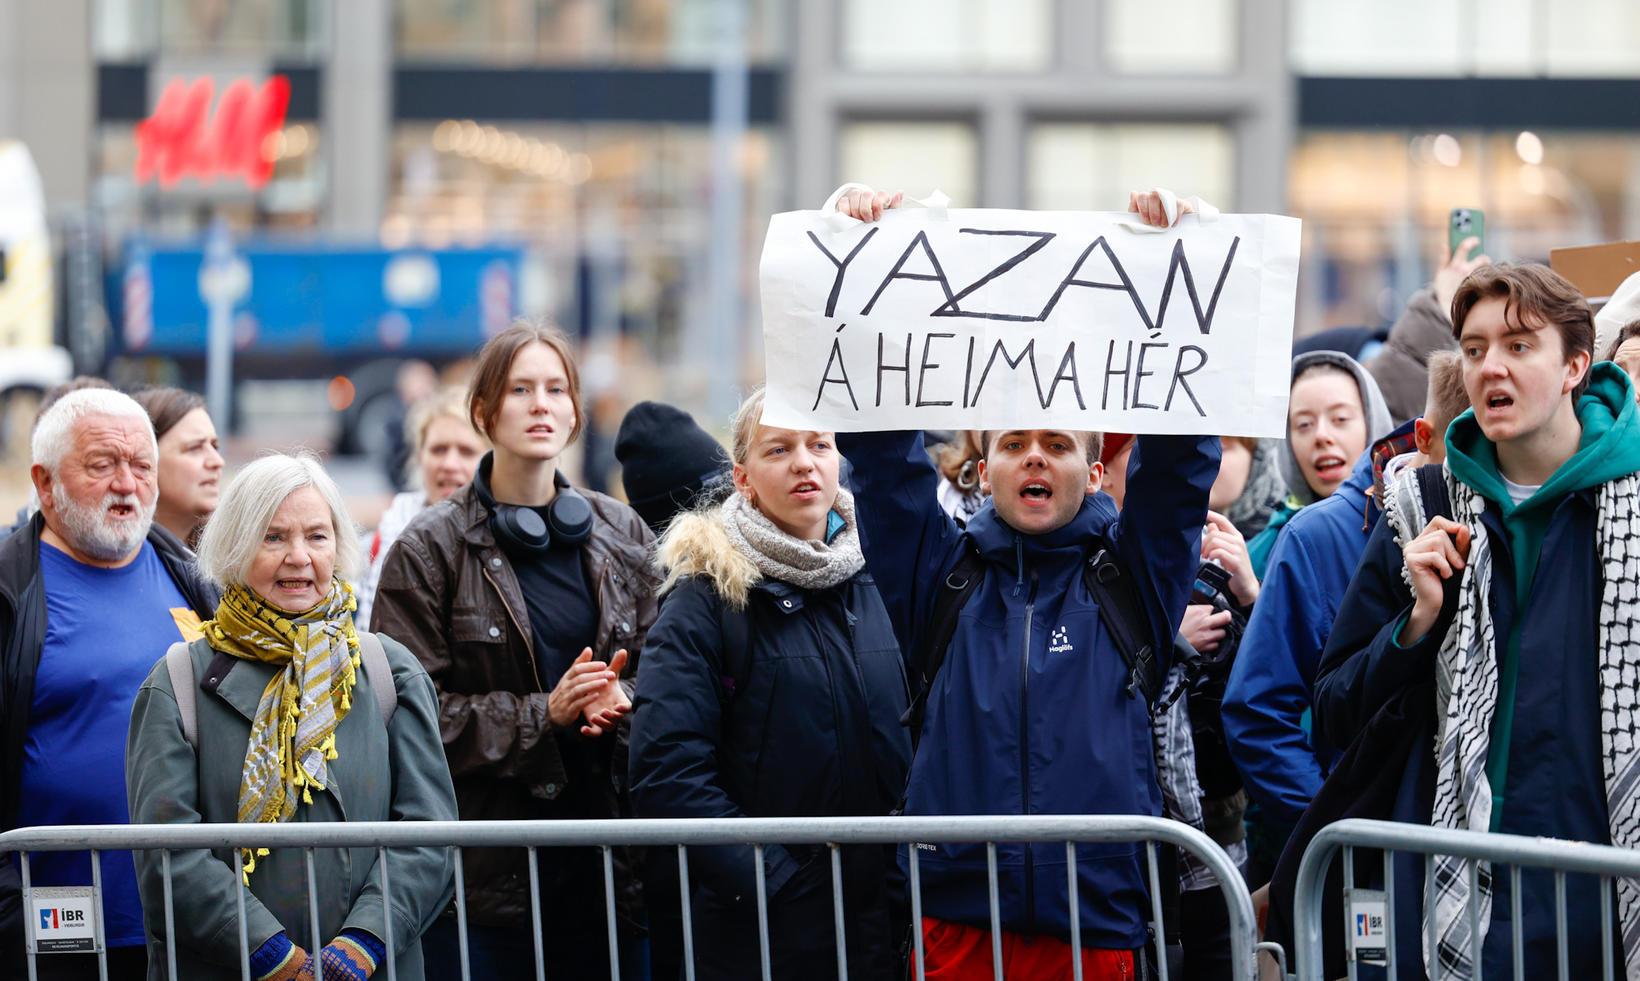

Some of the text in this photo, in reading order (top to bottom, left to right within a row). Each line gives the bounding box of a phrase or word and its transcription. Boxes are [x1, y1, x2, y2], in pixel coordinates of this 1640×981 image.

[806, 226, 1240, 335] YAZAN
[812, 323, 1208, 417] Á HEIMA HÉR
[61, 908, 85, 922] ÍBR
